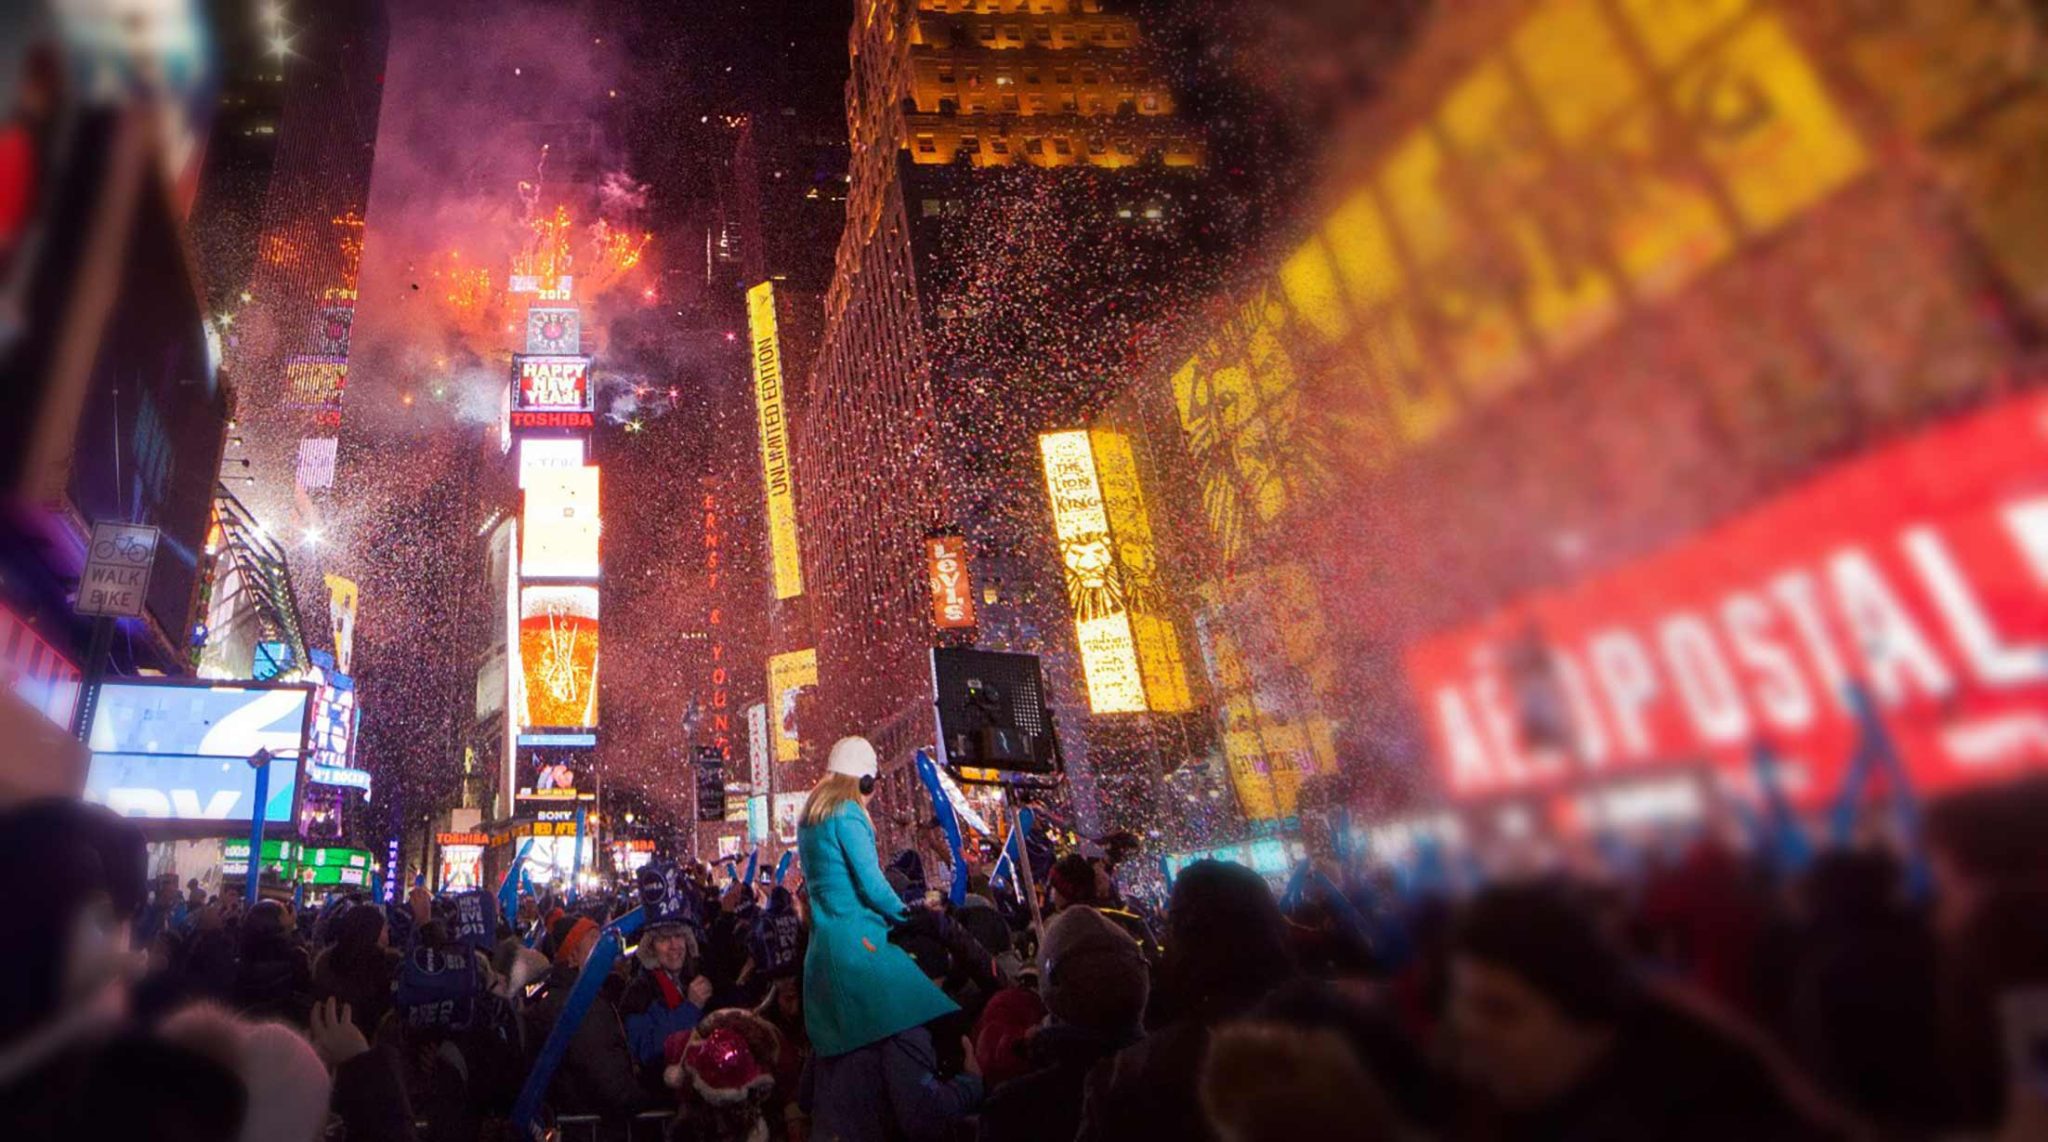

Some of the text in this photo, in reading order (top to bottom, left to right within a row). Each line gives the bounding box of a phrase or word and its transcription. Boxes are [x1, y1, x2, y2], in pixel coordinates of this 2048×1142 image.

[538, 289, 571, 300] 2013
[523, 364, 586, 378] HAPPY
[531, 377, 577, 391] NEW
[514, 413, 593, 425] TOSHIBA
[758, 337, 788, 497] UNLIMITED EDITION
[1056, 463, 1082, 474] THE
[1055, 495, 1098, 513] KING
[703, 495, 719, 589] ERNST
[92, 566, 141, 587] WALK
[91, 588, 132, 608] BIKE
[710, 608, 721, 624] &
[537, 811, 573, 821] SONY
[437, 833, 488, 845] TOSHIBA
